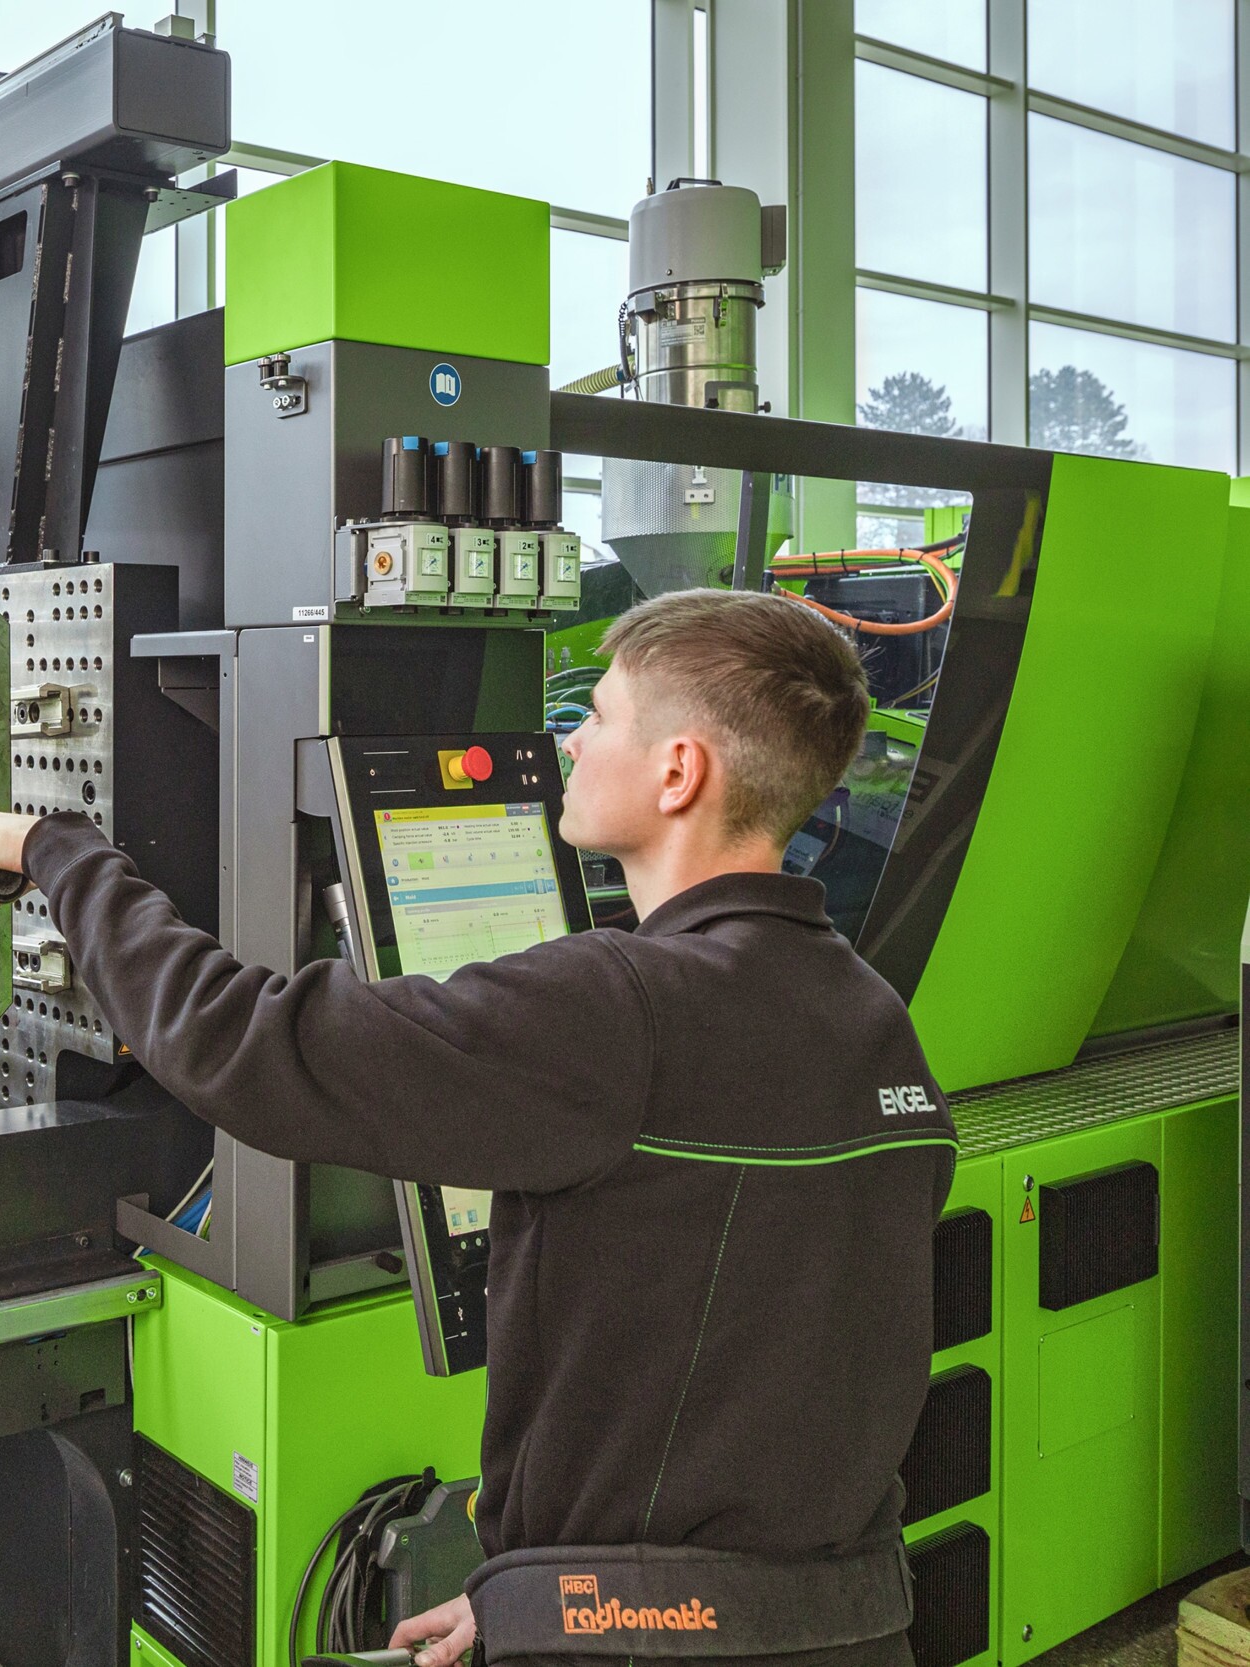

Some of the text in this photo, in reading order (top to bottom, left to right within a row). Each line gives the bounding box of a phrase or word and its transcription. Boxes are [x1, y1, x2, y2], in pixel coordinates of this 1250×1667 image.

[522, 542, 527, 550] 2
[878, 1085, 937, 1115] ENGEL
[564, 1580, 594, 1595] HBC
[566, 1597, 718, 1631] radiomatic
